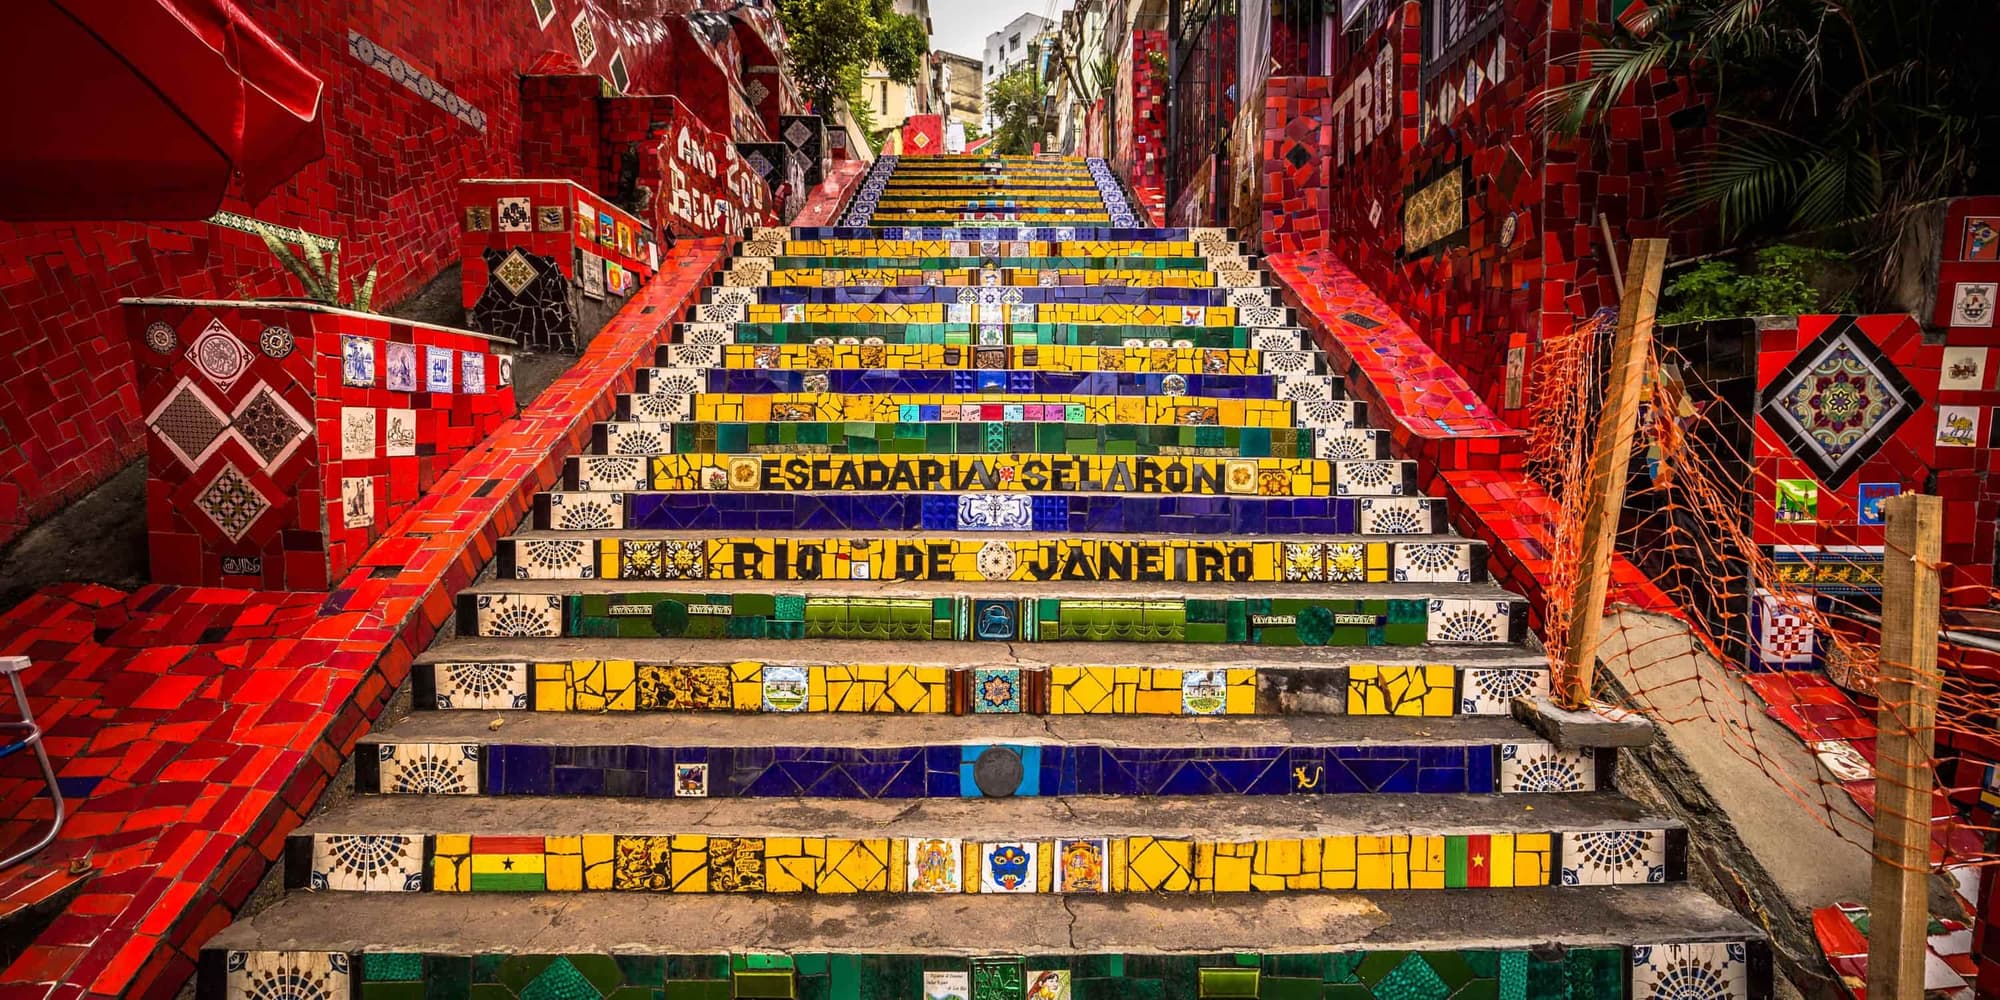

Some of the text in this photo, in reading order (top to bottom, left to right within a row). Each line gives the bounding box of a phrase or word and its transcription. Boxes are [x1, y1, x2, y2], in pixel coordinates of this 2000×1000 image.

[678, 126, 716, 179] ANO
[760, 460, 993, 490] ESCADARIA
[733, 543, 1254, 582] RIO DE JANEIRO
